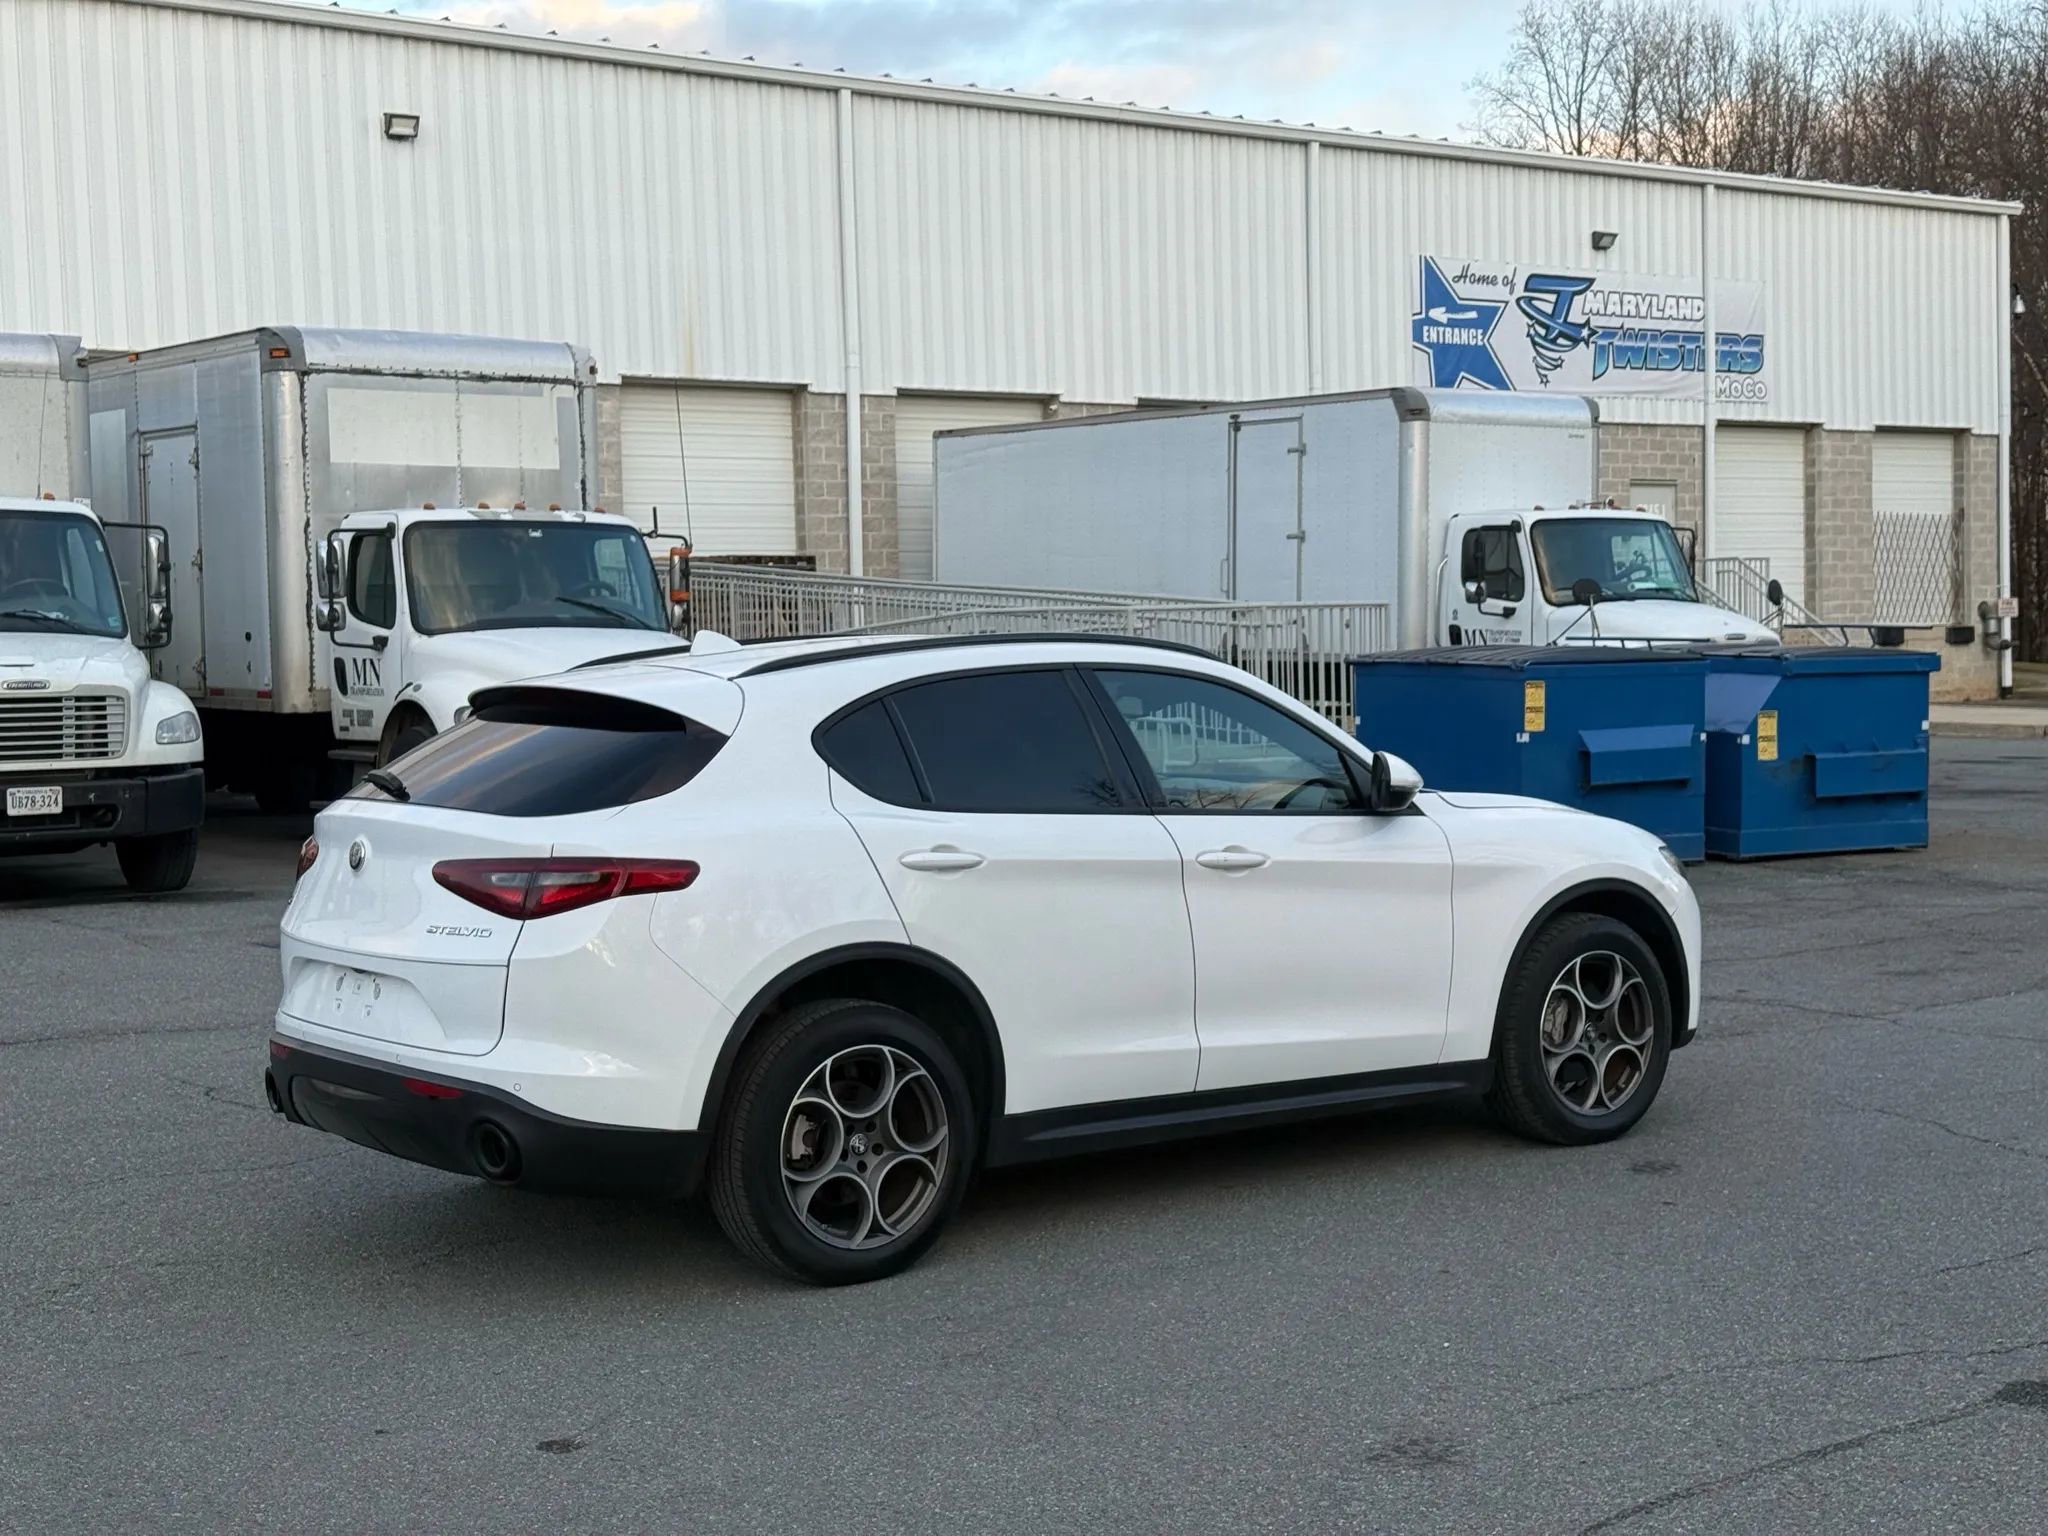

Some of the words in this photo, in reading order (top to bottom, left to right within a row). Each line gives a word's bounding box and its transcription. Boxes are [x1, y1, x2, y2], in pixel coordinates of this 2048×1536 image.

[1451, 262, 1499, 287] Home
[1501, 266, 1517, 296] of
[1582, 290, 1706, 322] MARYLAND
[1422, 325, 1484, 346] ENTRANCE
[1714, 375, 1767, 400] MoCo
[1464, 628, 1489, 647] MN
[352, 657, 382, 686] MN
[11, 794, 59, 810] UB78-324
[426, 924, 493, 938] STELVIO
